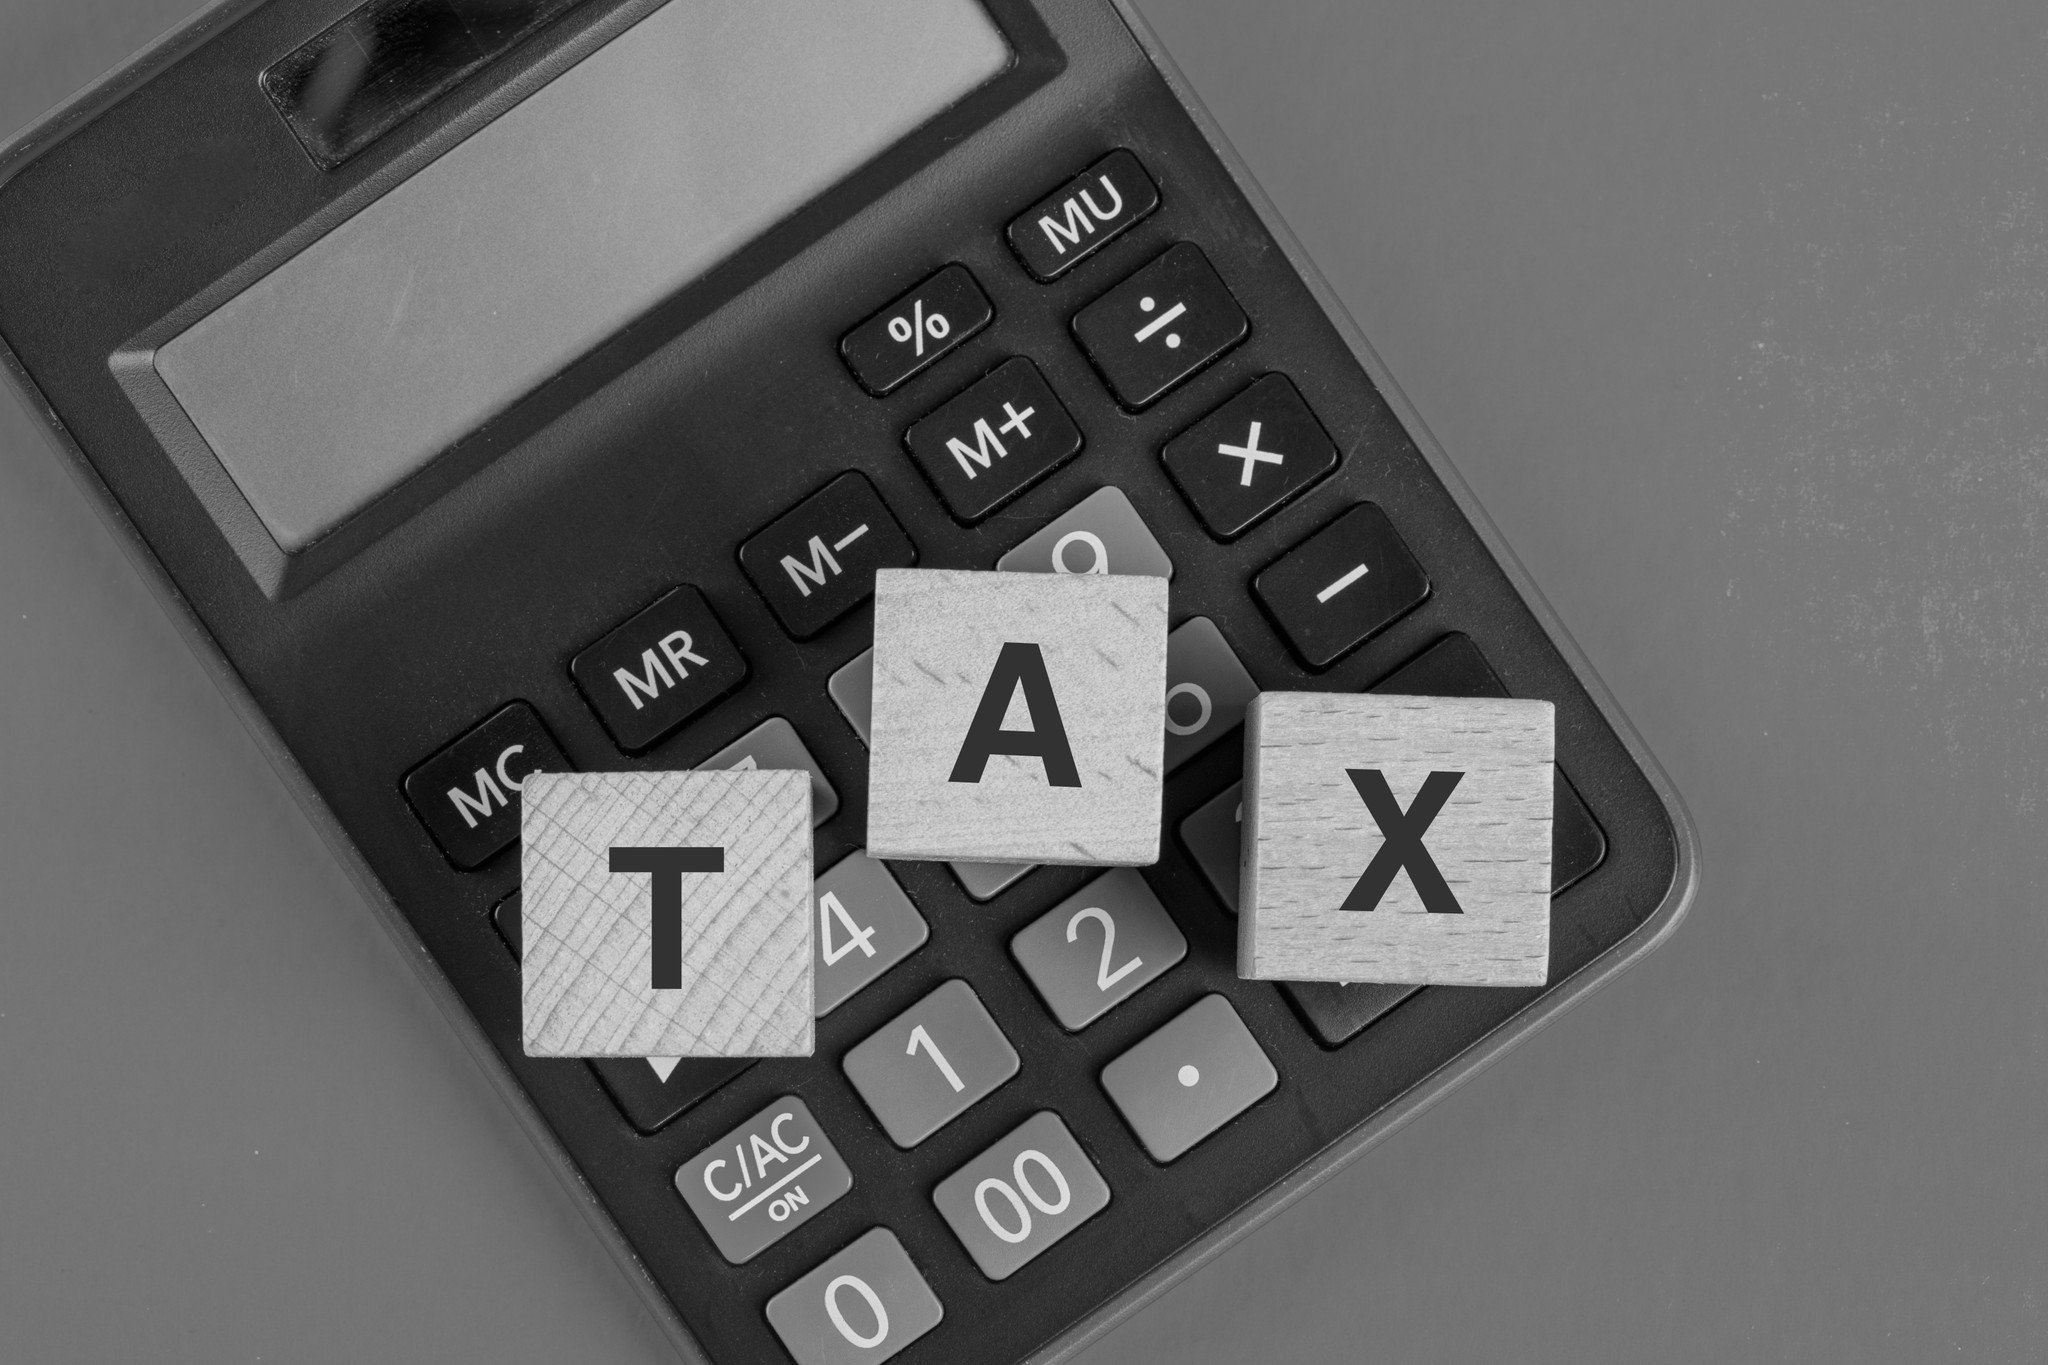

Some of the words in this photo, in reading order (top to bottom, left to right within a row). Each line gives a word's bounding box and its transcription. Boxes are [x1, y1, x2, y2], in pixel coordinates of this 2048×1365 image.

[1039, 176, 1122, 253] MU
[889, 300, 949, 356] %
[946, 403, 1034, 479] M+
[614, 631, 708, 709] MR
[448, 745, 525, 827] MC
[819, 891, 876, 966] 4
[1067, 908, 1142, 991] 2
[906, 1025, 965, 1092] 1
[704, 1113, 809, 1201] C/AC
[769, 1186, 809, 1221] ON
[975, 1150, 1070, 1243] 00
[825, 1275, 888, 1348] 0
